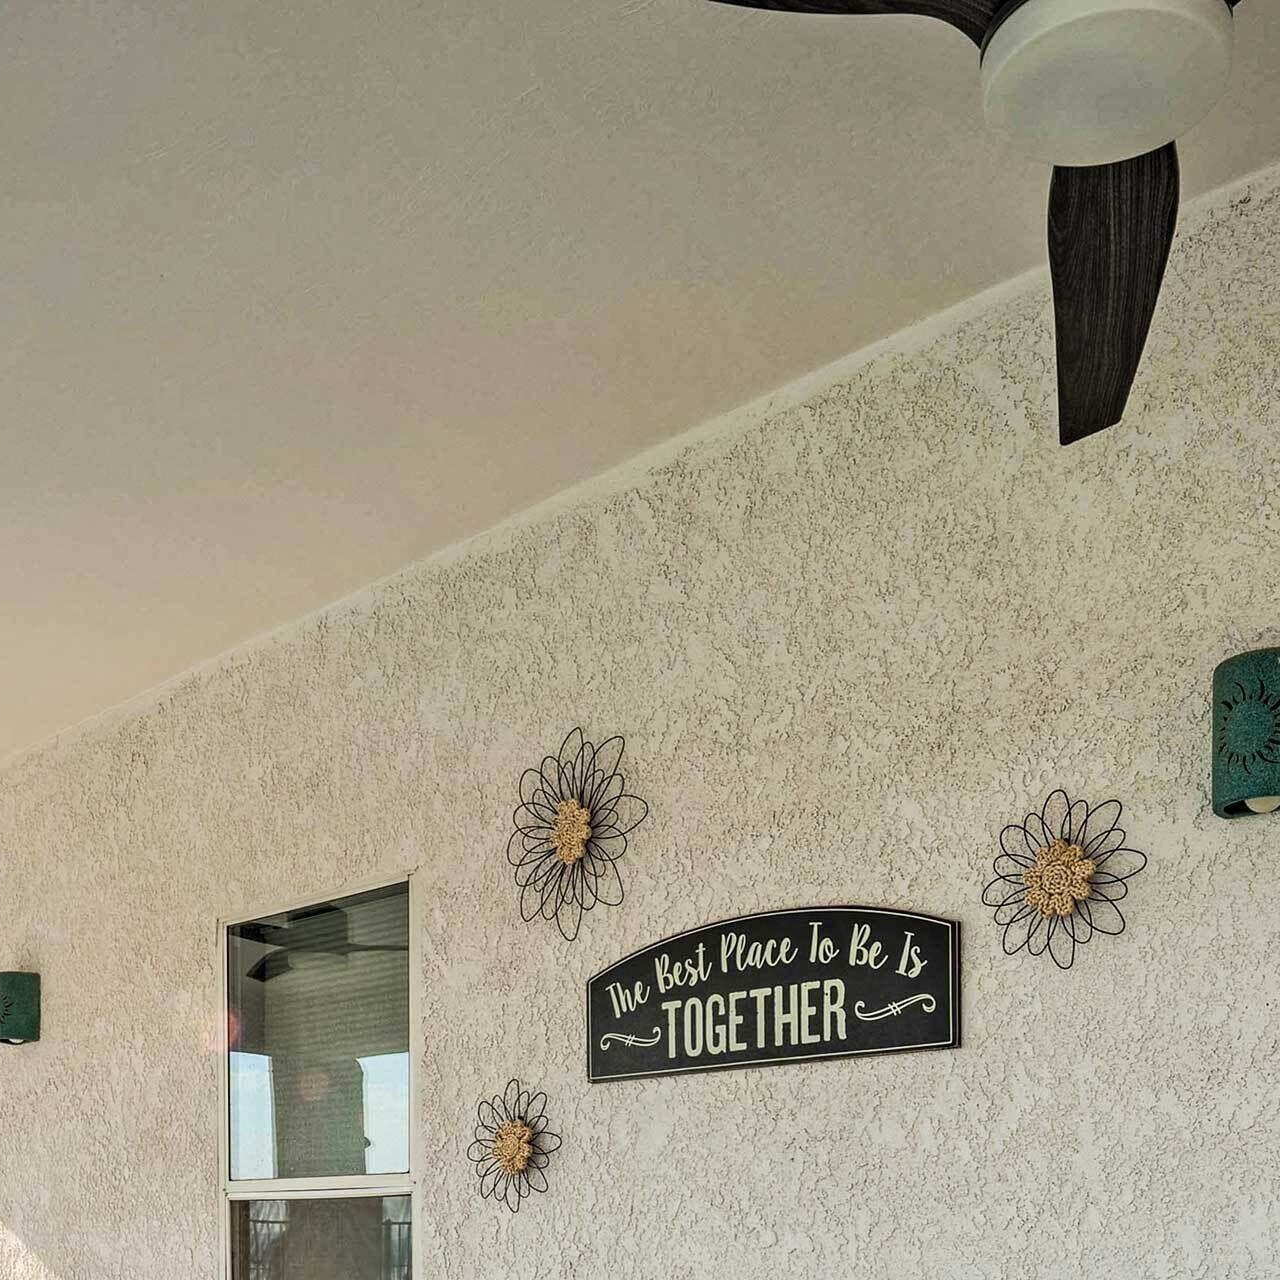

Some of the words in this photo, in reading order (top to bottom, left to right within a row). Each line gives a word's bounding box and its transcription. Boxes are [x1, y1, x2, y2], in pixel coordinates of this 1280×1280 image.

[604, 980, 651, 1019] The
[654, 942, 713, 994] Best
[720, 932, 799, 976] Place
[808, 921, 840, 964] To
[848, 923, 889, 970] Be
[894, 931, 928, 979] Is
[661, 978, 848, 1059] TOGETHER
